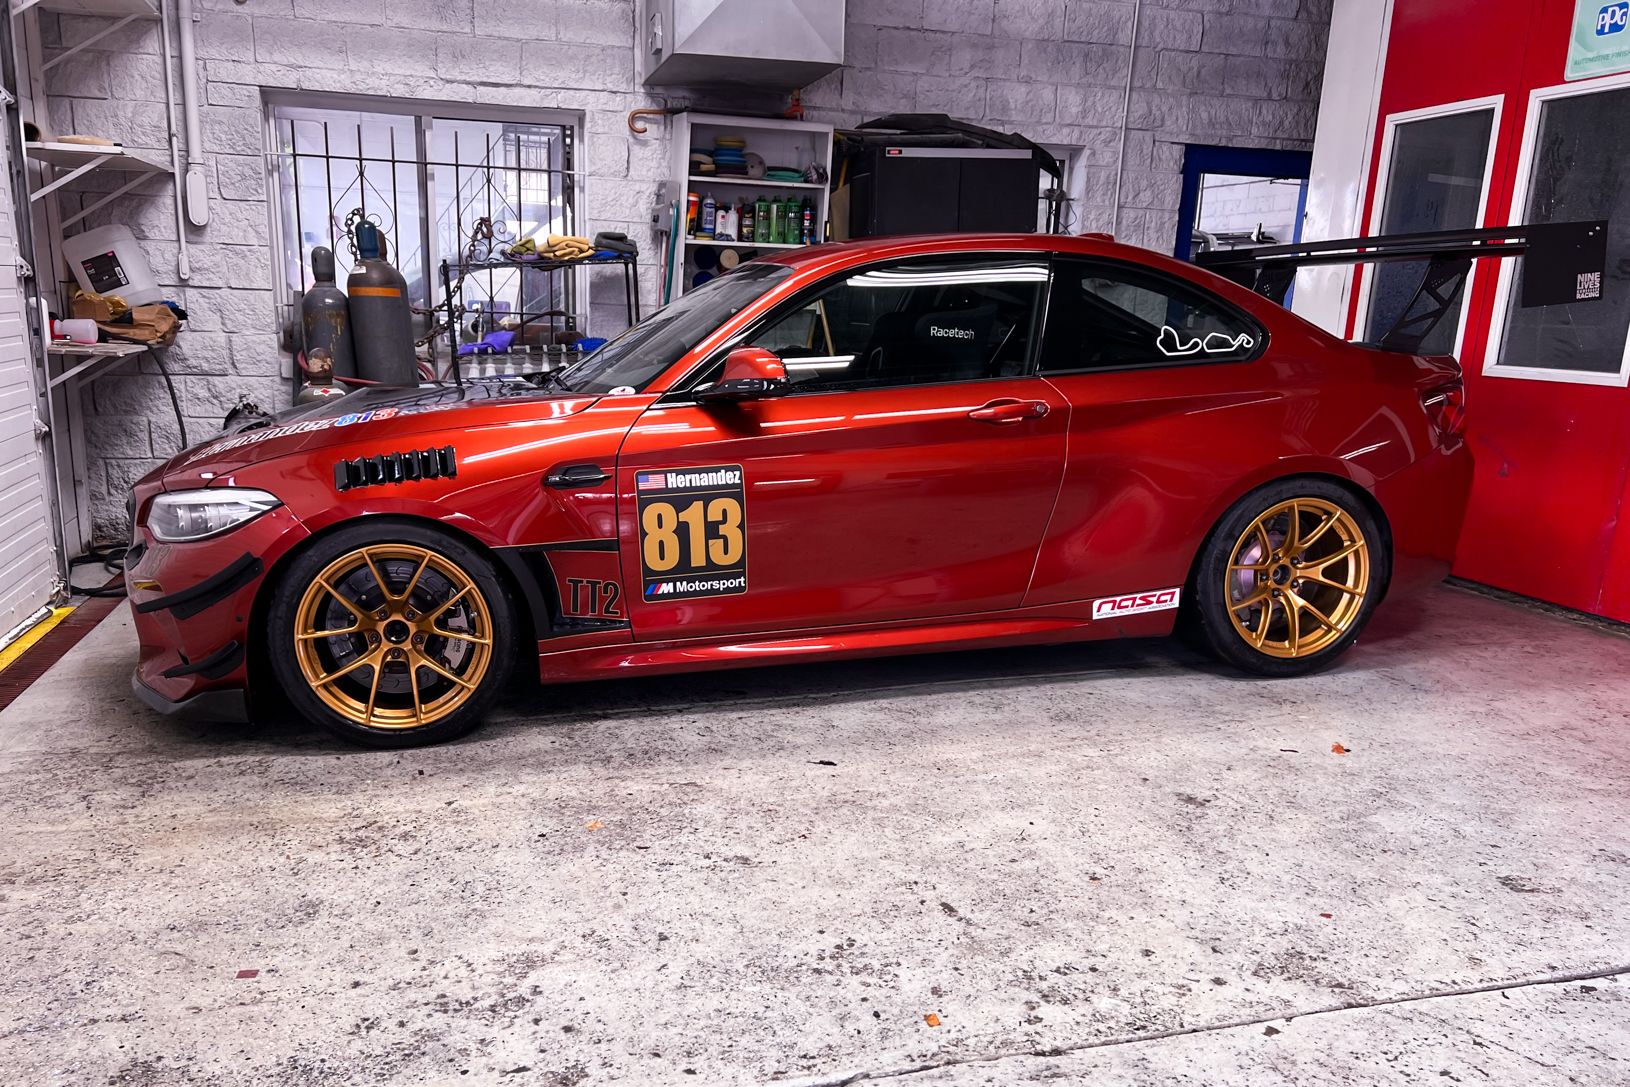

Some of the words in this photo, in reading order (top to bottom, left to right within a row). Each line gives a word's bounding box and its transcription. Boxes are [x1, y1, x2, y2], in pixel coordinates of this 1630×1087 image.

[1597, 6, 1628, 33] PPG
[1577, 272, 1600, 282] NINE
[1577, 280, 1600, 290] LIVES
[1576, 291, 1599, 299] RACING
[930, 325, 975, 340] Racetech
[666, 469, 741, 489] Hernandez
[642, 497, 744, 572] 813
[676, 576, 746, 593] Motorsport
[566, 577, 621, 617] TT2
